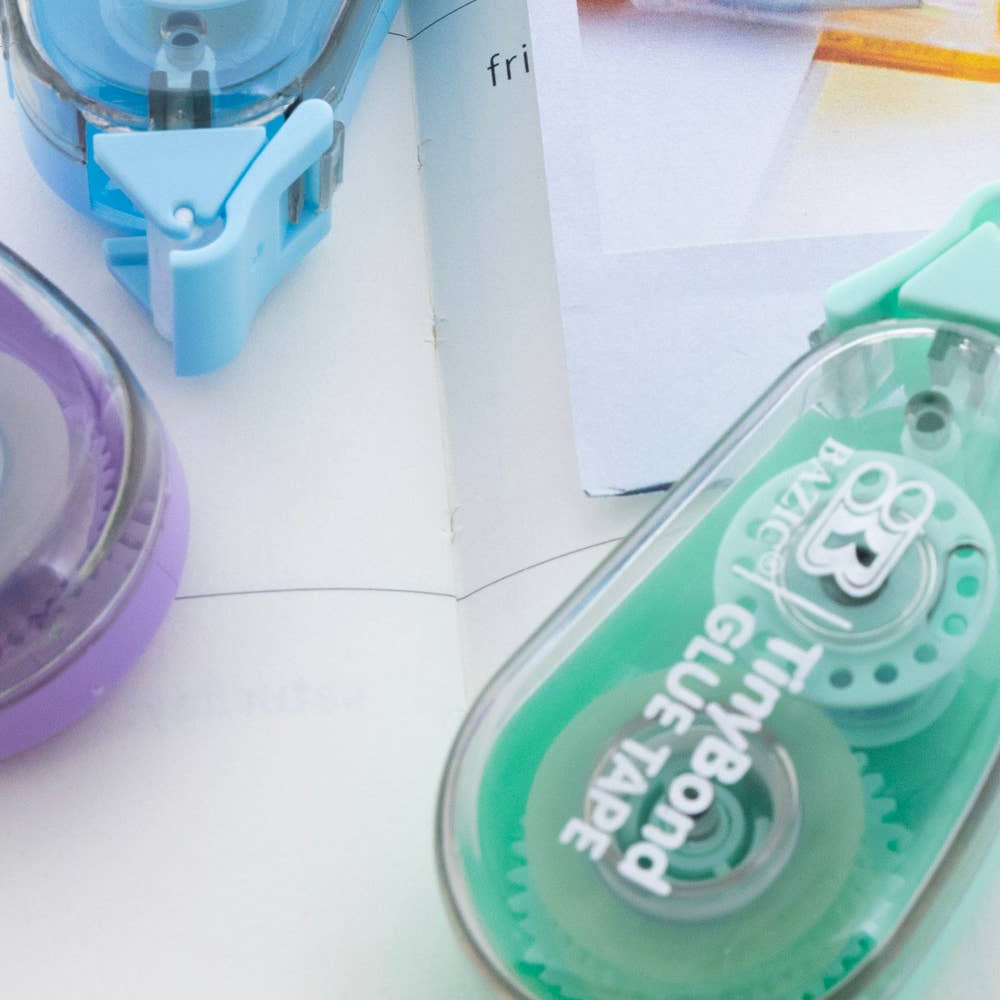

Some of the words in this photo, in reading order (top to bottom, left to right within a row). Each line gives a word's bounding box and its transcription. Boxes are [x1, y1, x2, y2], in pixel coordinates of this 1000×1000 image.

[487, 43, 530, 87] fri
[643, 602, 756, 736] GLUE
[559, 738, 672, 861] TAPE
[617, 635, 824, 898] TinyBond
